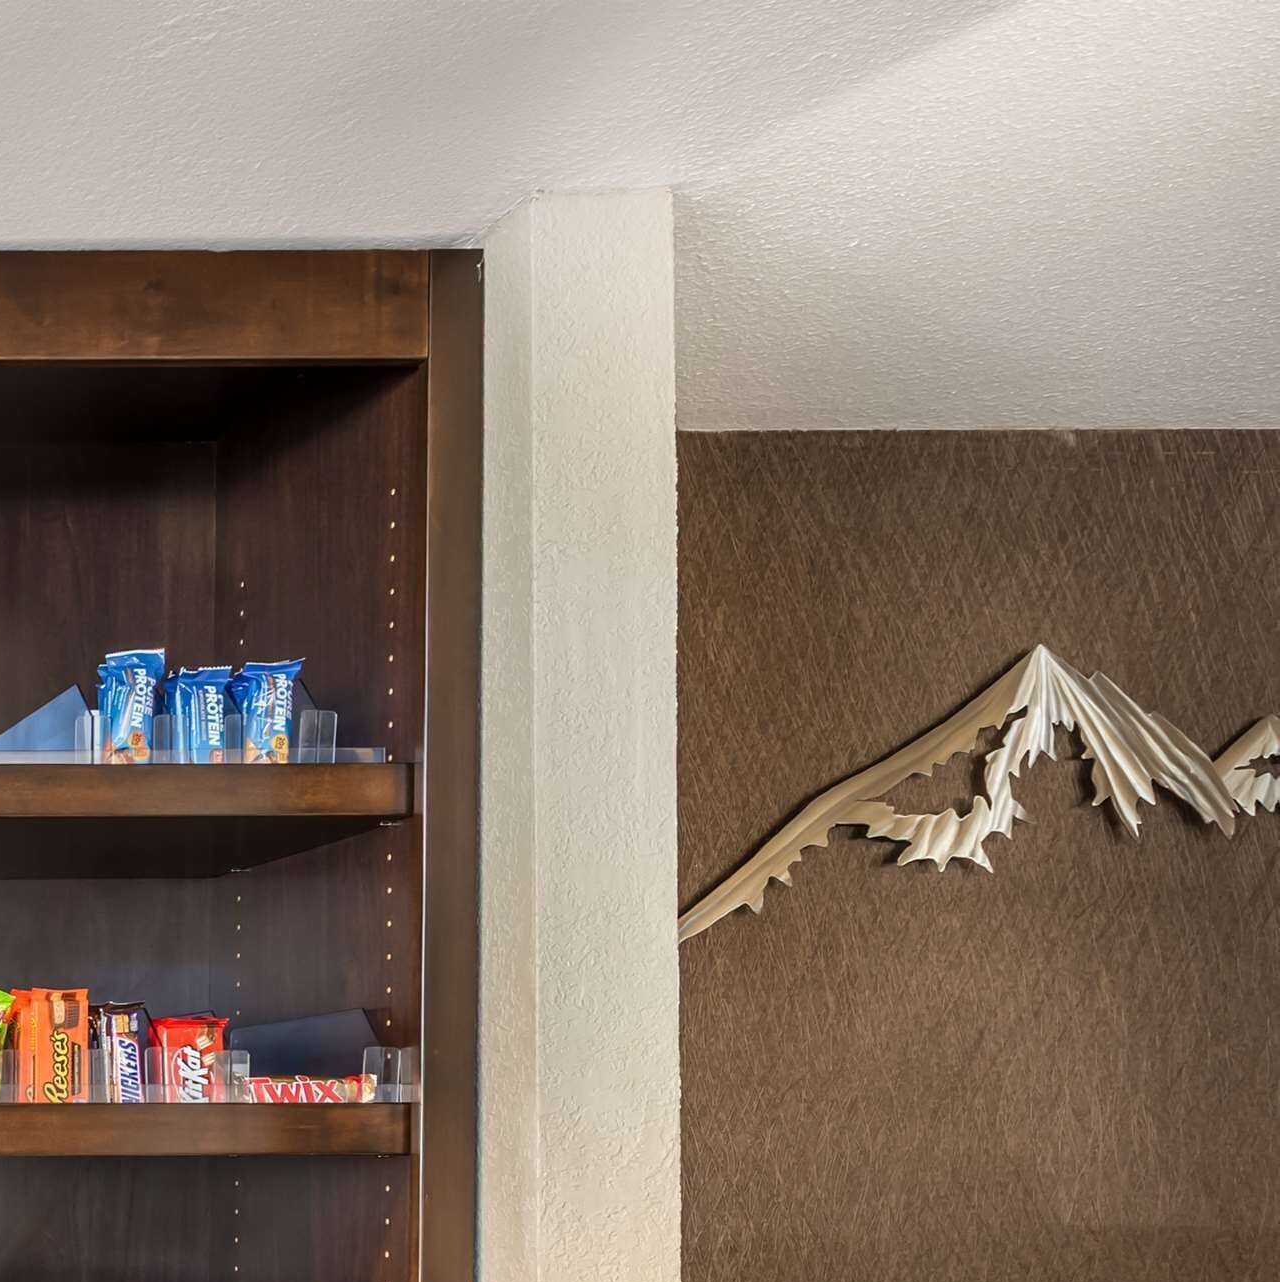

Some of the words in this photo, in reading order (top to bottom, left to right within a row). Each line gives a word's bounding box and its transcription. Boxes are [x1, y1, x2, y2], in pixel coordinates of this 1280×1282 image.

[130, 668, 146, 728] PROTEIN
[144, 677, 157, 717] PURE
[204, 686, 221, 745] PROTEIN
[273, 673, 288, 732] PROTEIN
